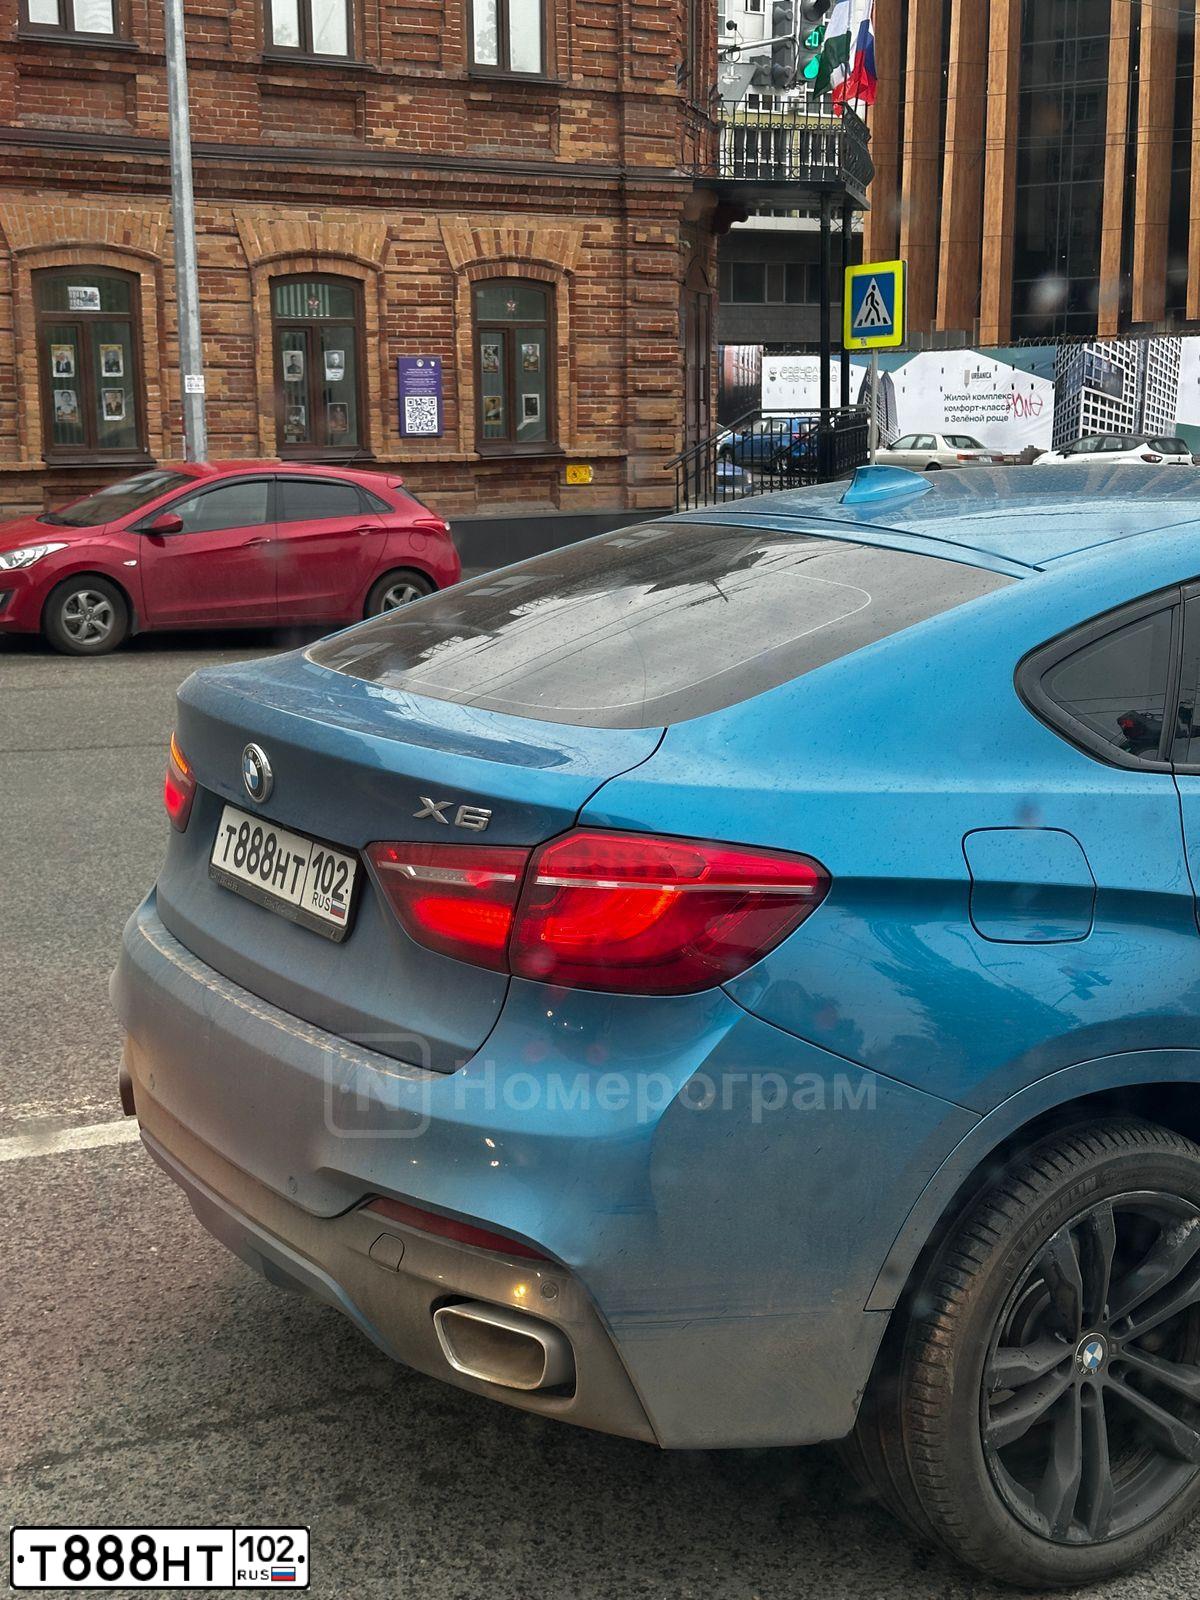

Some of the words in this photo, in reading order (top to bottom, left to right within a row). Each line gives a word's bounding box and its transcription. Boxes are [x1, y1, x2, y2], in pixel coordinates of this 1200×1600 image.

[971, 371, 992, 379] URBANICA
[944, 393, 971, 401] Жилой
[972, 392, 1013, 401] комплекс
[944, 403, 1011, 413] комфорт-класса
[951, 414, 985, 423] Зелёной
[986, 415, 1009, 423] роще
[413, 796, 492, 831] X6
[222, 821, 305, 895] Т888НТ
[312, 851, 348, 902] 102
[311, 892, 331, 911] RUS
[1023, 1174, 1097, 1248] MICHELIN
